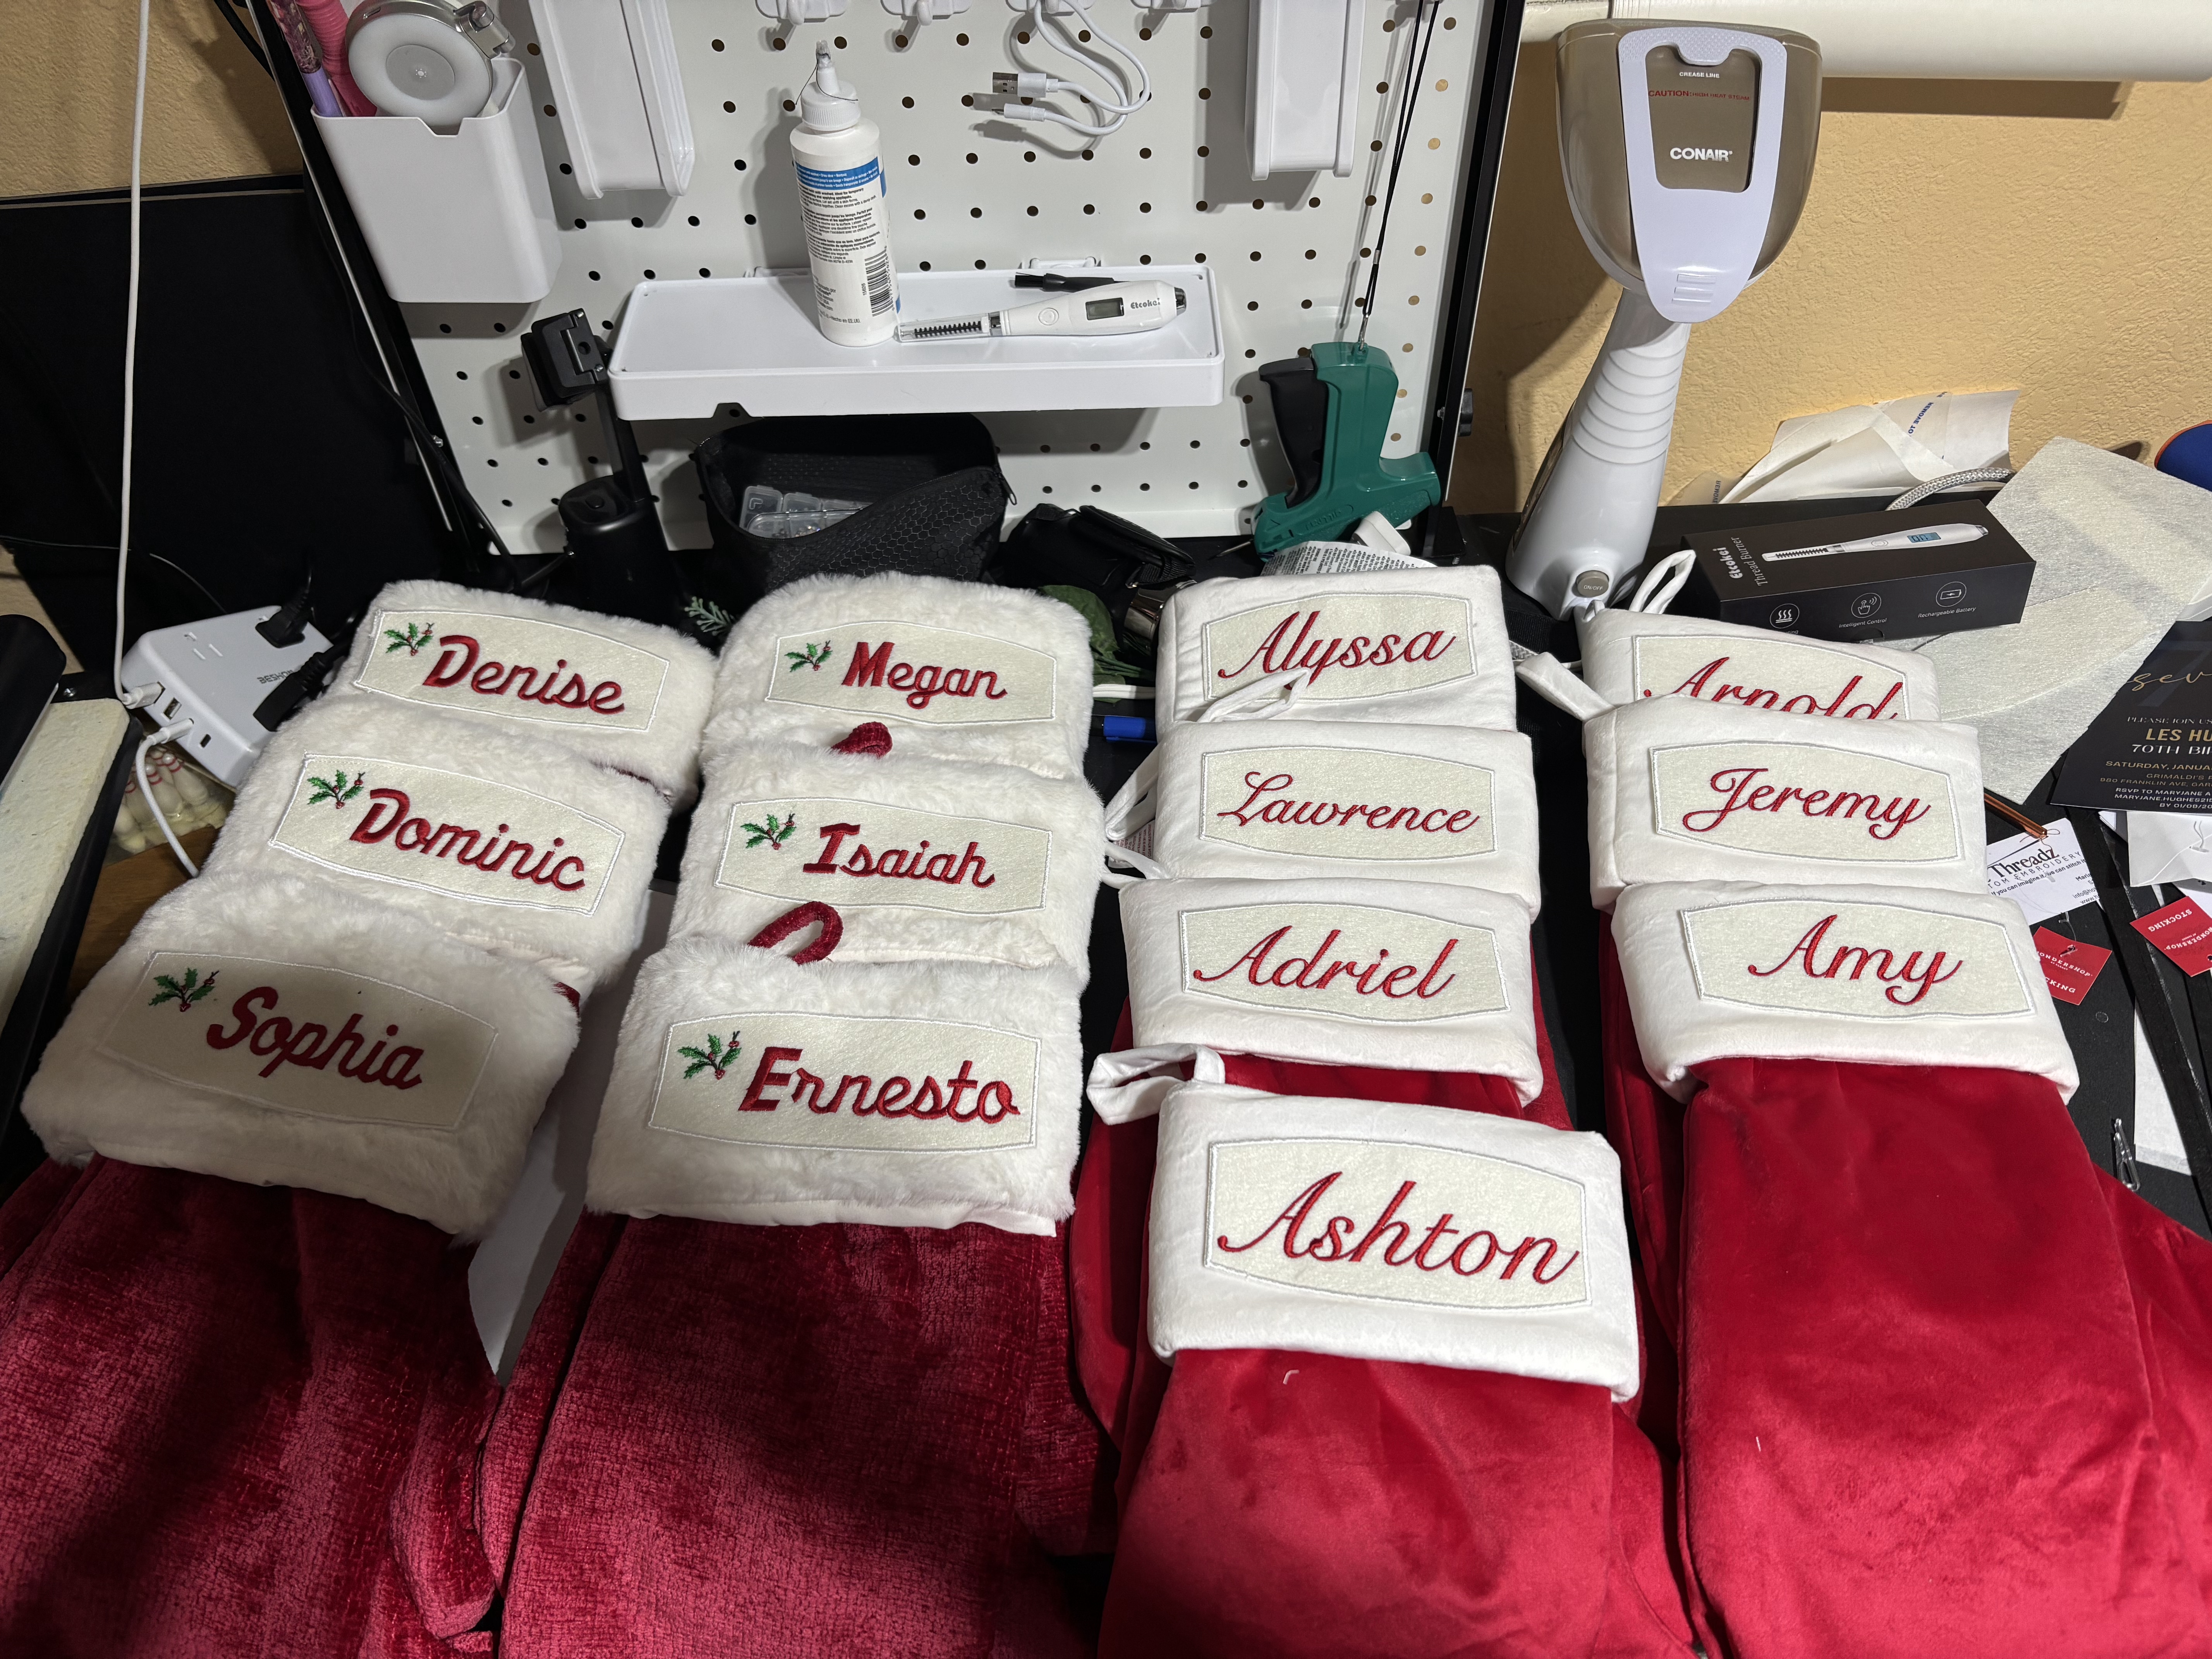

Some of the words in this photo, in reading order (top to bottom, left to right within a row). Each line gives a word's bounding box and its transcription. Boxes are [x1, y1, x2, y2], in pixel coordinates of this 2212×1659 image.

[1670, 148, 1729, 162] CONAIR
[1731, 537, 1752, 560] Burner
[1744, 561, 1768, 586] Thread
[1918, 609, 1955, 618] Rechargeable
[423, 635, 624, 715] Denise
[842, 642, 1007, 709] Megan
[1218, 611, 1456, 691] Alyssa
[2132, 744, 2180, 754] 70TH
[2146, 728, 2182, 741] LES
[2106, 761, 2169, 770] SATURDAY,
[1218, 772, 1480, 833] Lawrence
[1683, 769, 1931, 840] Jeremy
[350, 788, 585, 891] Dominic
[803, 823, 995, 888] Isaiah
[1987, 848, 2060, 878] Threadz
[2014, 851, 2081, 879] EMBROIDERY
[2018, 876, 2039, 887] imagine
[2066, 860, 2082, 869] stitch
[2148, 909, 2192, 932] STOCKING
[1193, 926, 1459, 999] Adriel
[1748, 915, 1963, 1006] Amy
[208, 988, 422, 1089] Sophia
[739, 1047, 1021, 1124] Ernesto
[1218, 1172, 1580, 1285] Ashton
